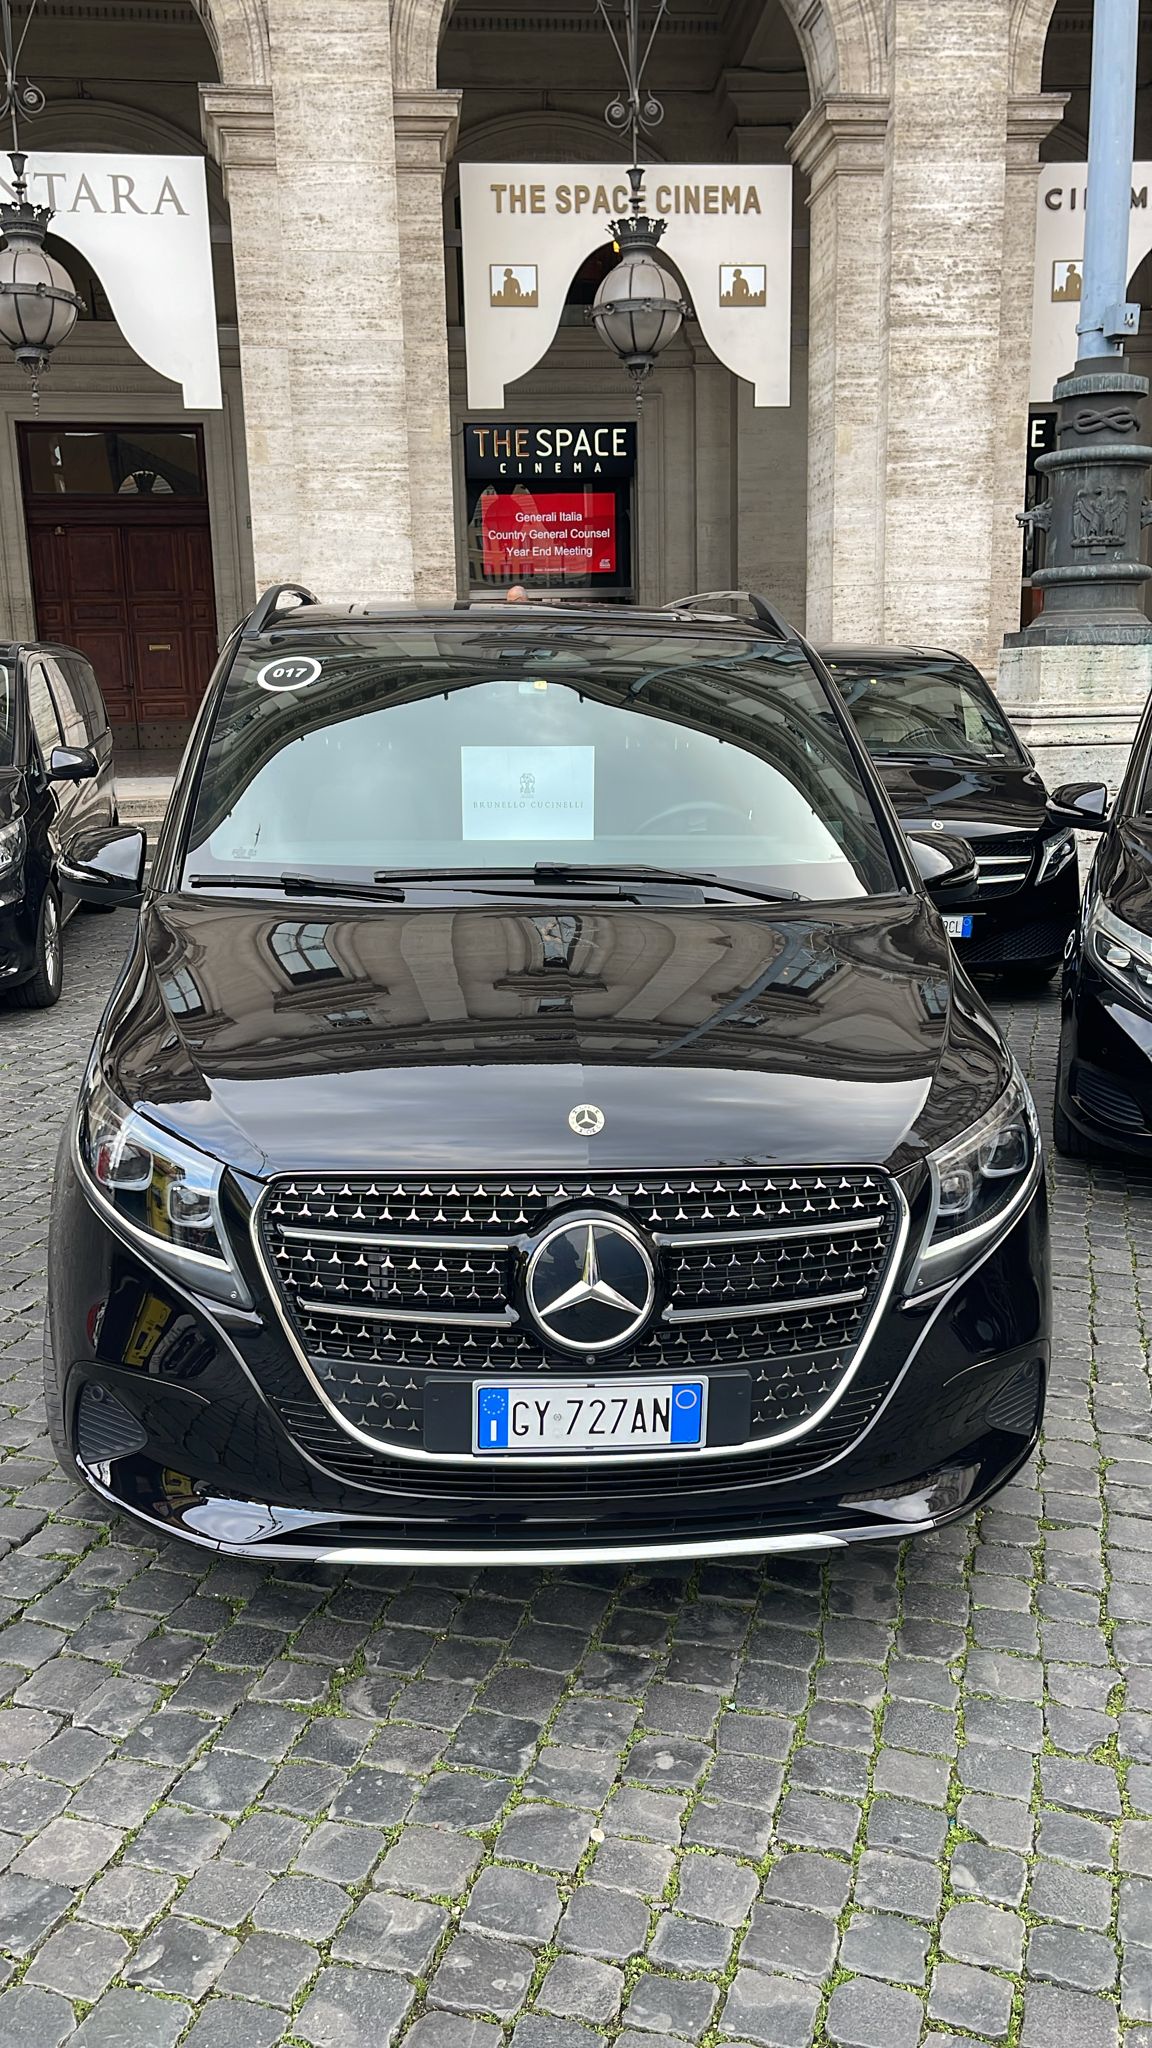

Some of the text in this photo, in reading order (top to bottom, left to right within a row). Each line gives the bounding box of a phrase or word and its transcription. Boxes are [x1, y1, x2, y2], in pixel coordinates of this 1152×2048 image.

[490, 184, 762, 215] THE SPACE CINEMA
[473, 428, 628, 458] THE SPACE
[499, 462, 602, 474] CINEMA
[515, 512, 583, 523] Generali Italia
[488, 528, 610, 542] Country General Counsel
[506, 546, 593, 558] Year End Meeting
[272, 667, 308, 678] 017
[473, 801, 584, 809] BRUNELLO CUCINELLI
[512, 1397, 670, 1437] GY 727AN
